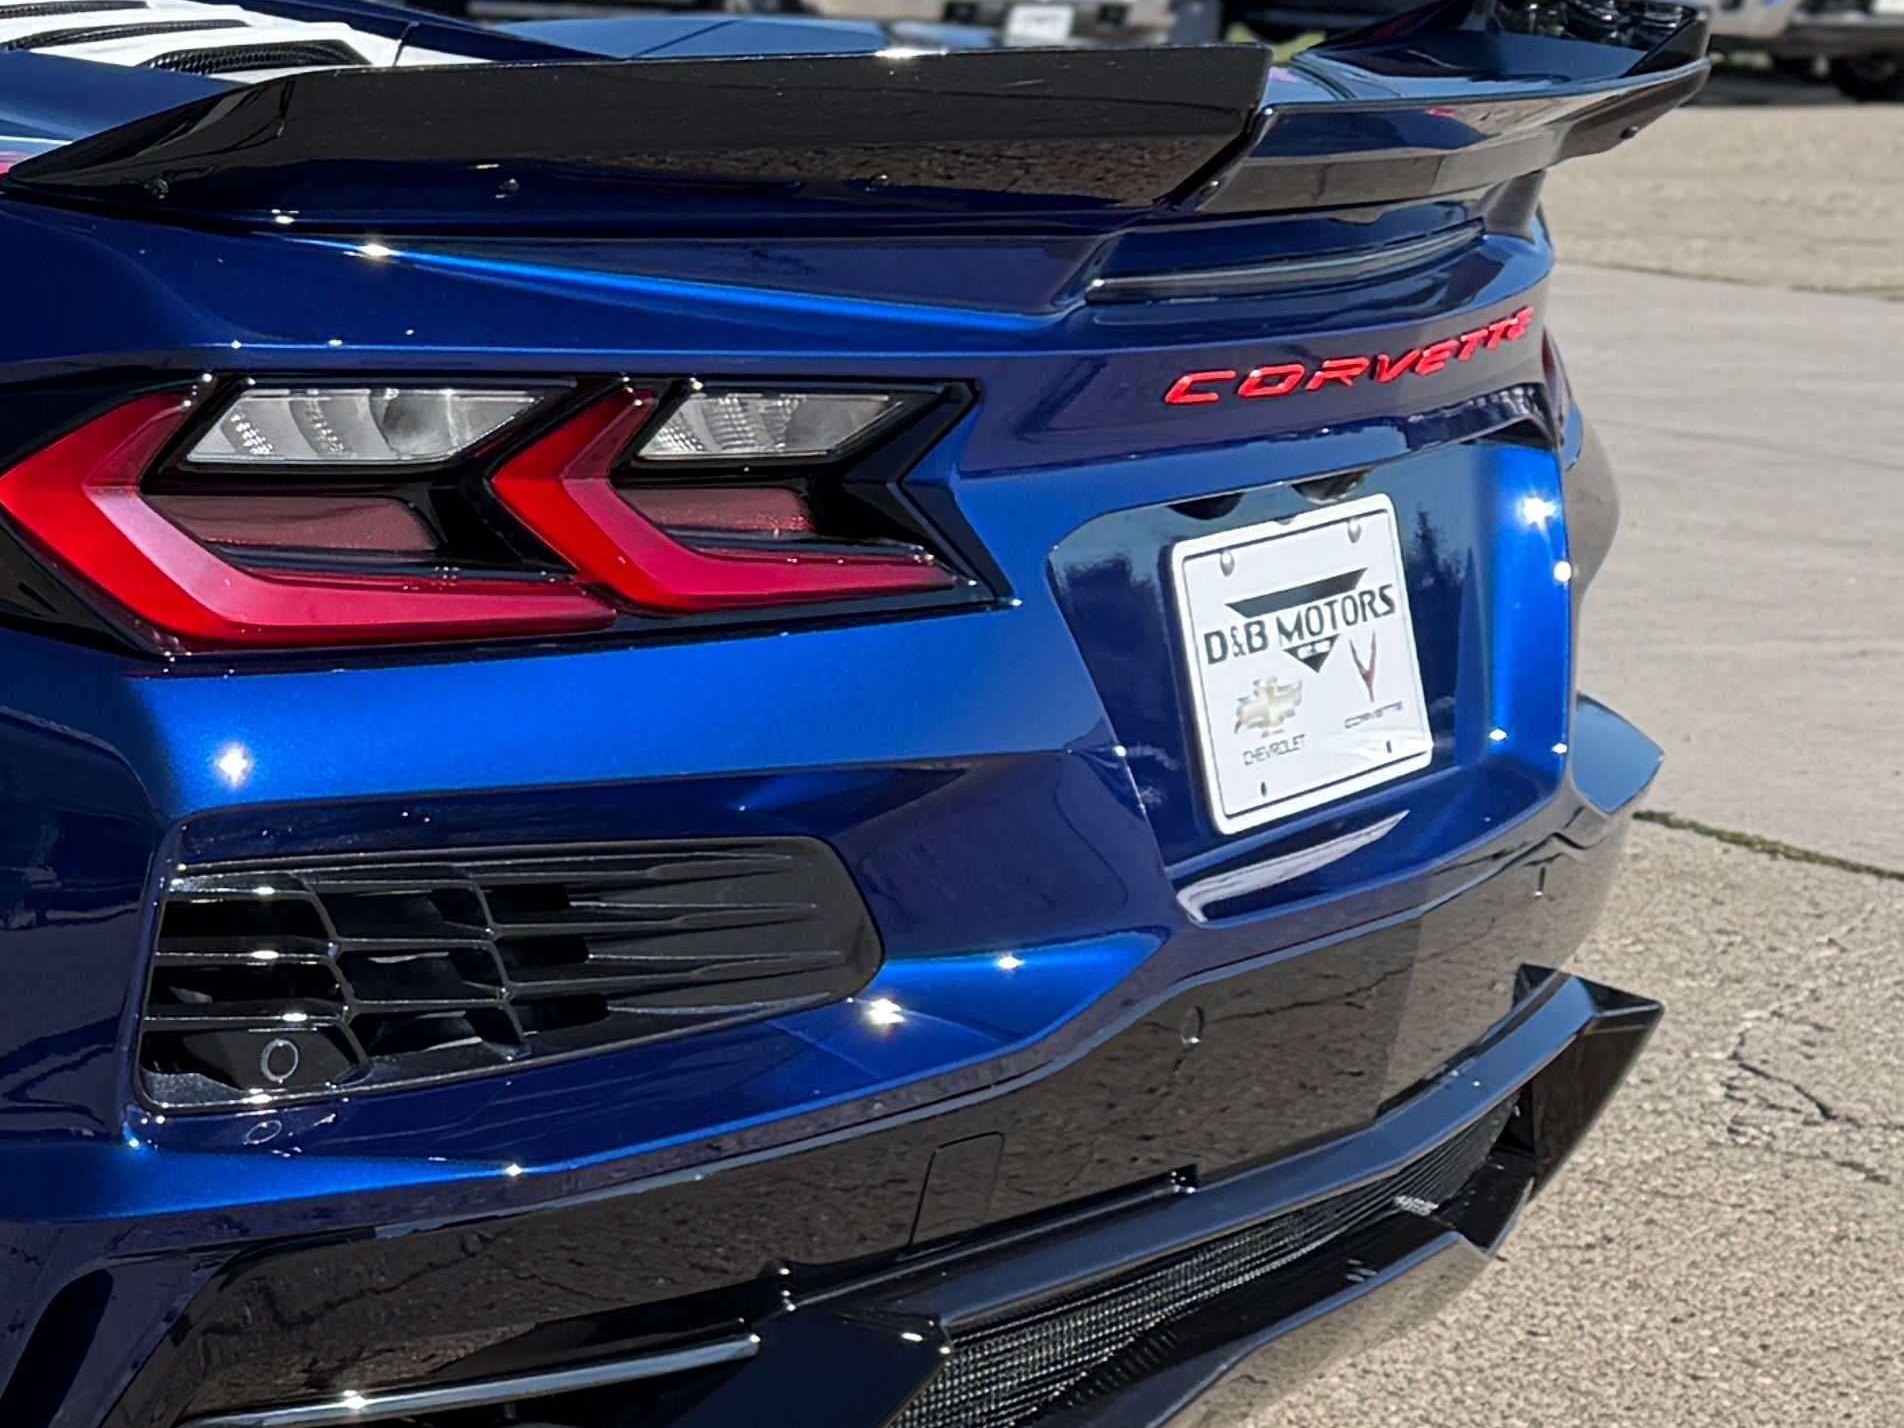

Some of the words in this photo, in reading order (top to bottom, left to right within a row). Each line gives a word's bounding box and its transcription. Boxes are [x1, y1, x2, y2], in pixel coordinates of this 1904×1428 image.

[1164, 304, 1535, 406] CORVETTE
[1204, 619, 1269, 666] D&B
[1276, 583, 1396, 646] MOTORS
